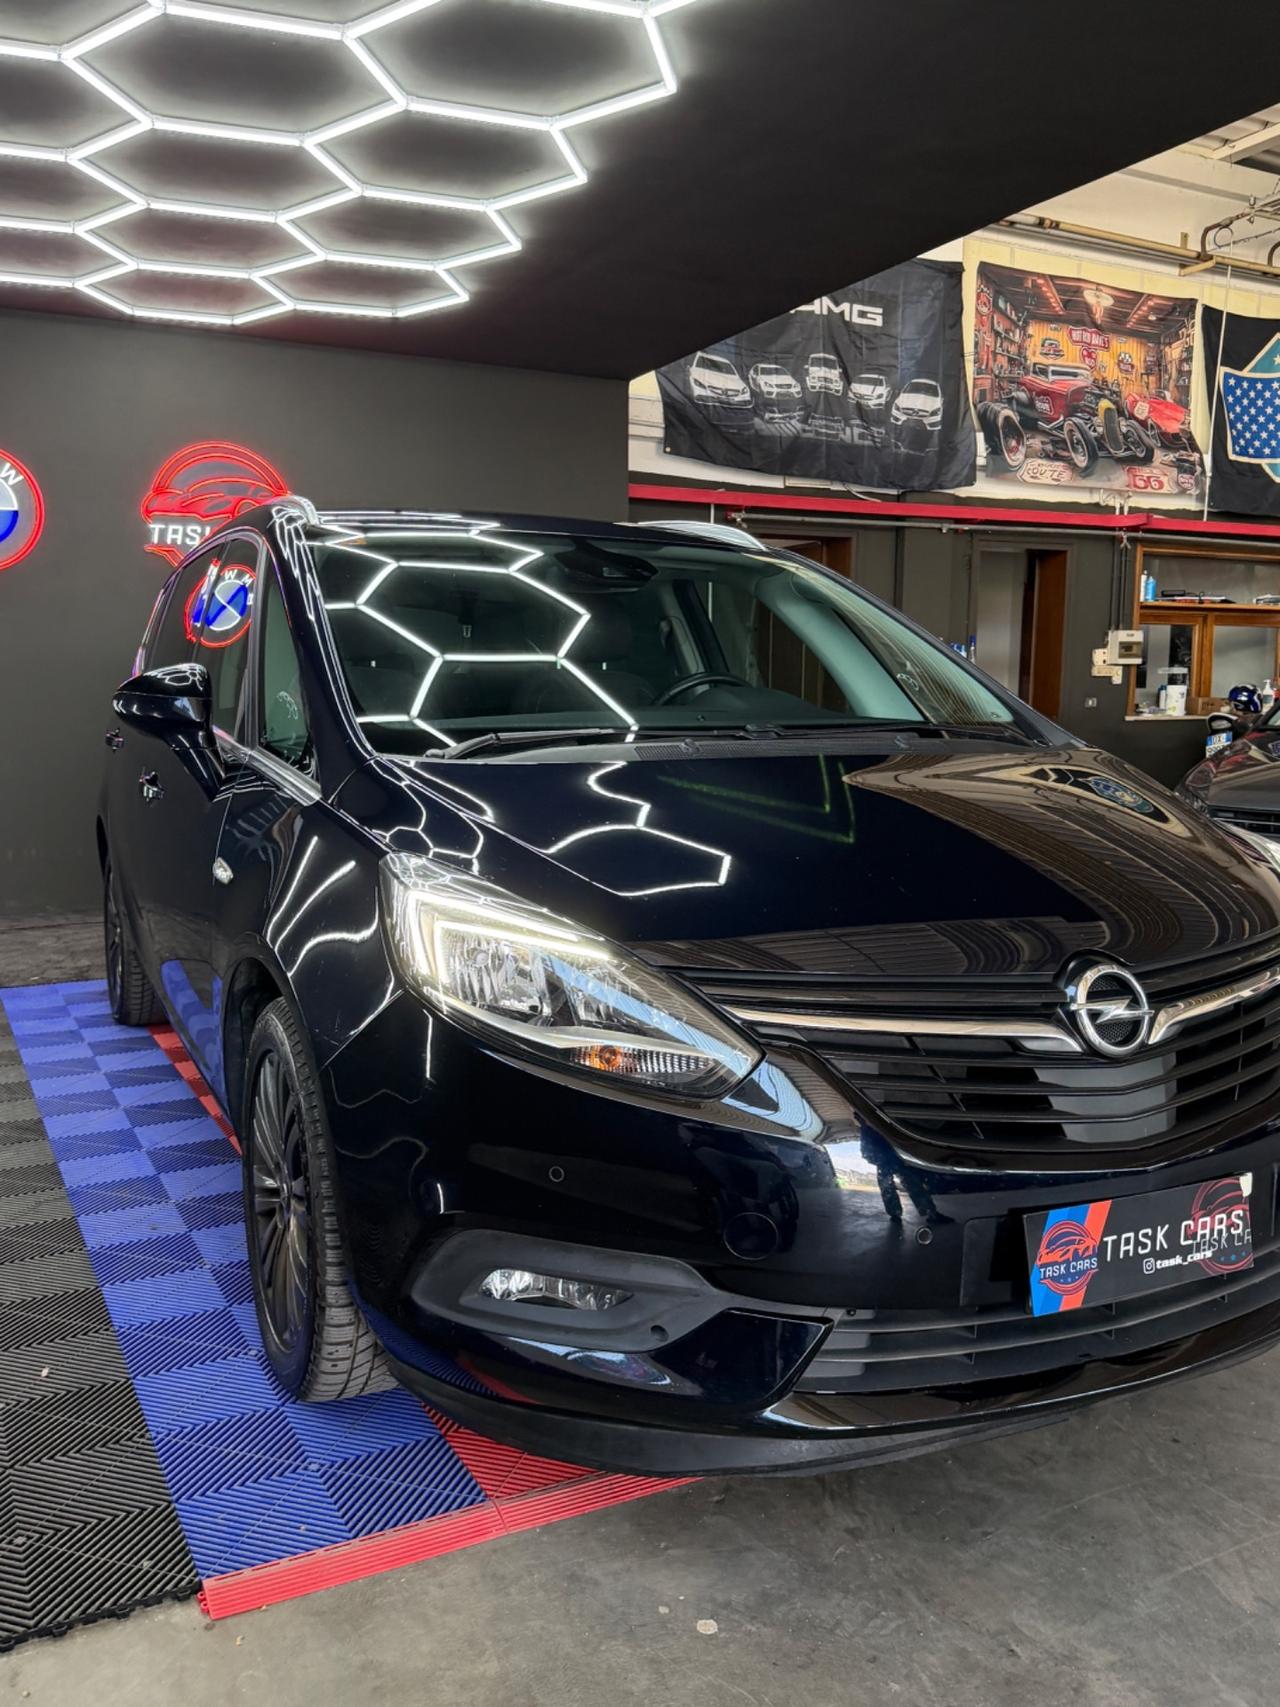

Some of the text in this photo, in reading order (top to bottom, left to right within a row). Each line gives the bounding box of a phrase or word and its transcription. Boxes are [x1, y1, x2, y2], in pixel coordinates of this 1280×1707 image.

[1102, 1210, 1244, 1262] TASK CARS
[1040, 1257, 1099, 1279] TASK CARS
[1156, 1250, 1213, 1270] task_cars
